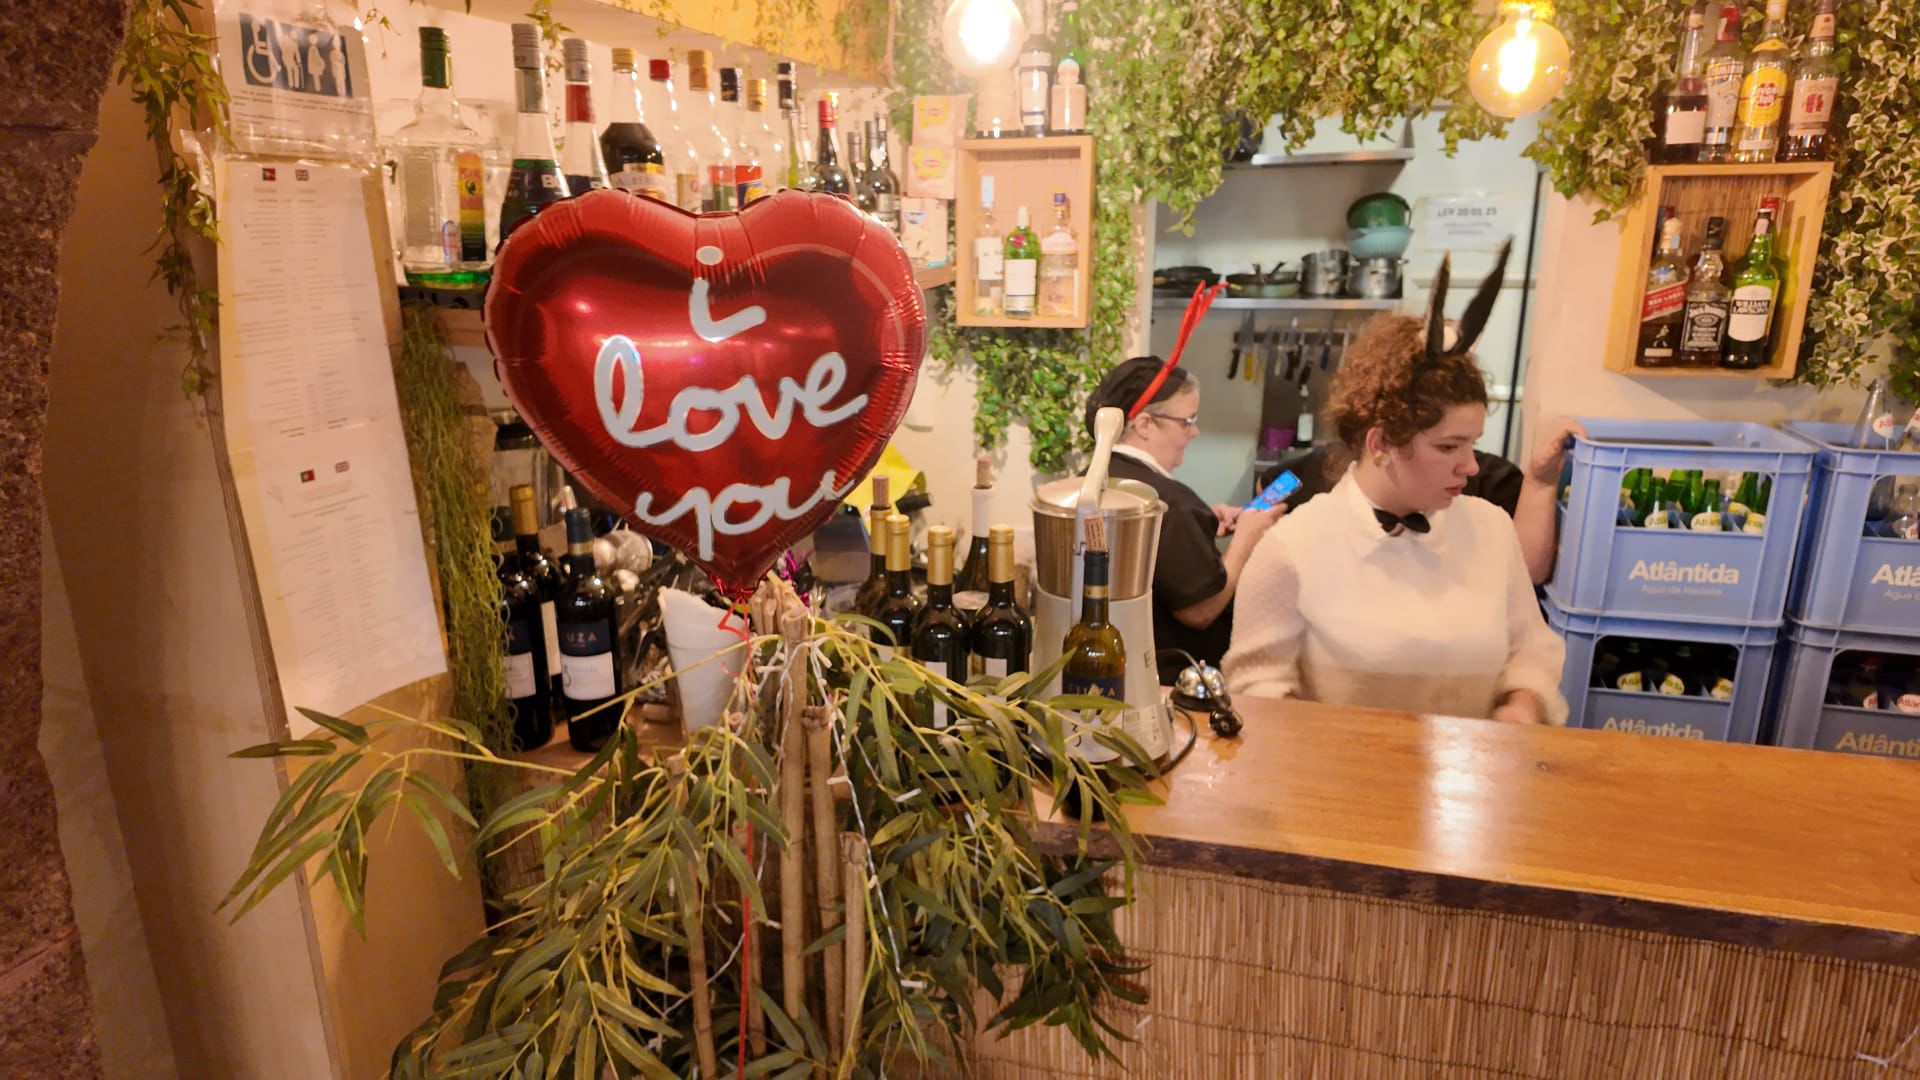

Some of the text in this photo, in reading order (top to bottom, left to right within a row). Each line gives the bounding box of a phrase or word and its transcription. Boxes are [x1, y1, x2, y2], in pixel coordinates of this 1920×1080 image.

[594, 334, 868, 452] love
[635, 469, 855, 562] you
[1628, 559, 1740, 584] Atlântida
